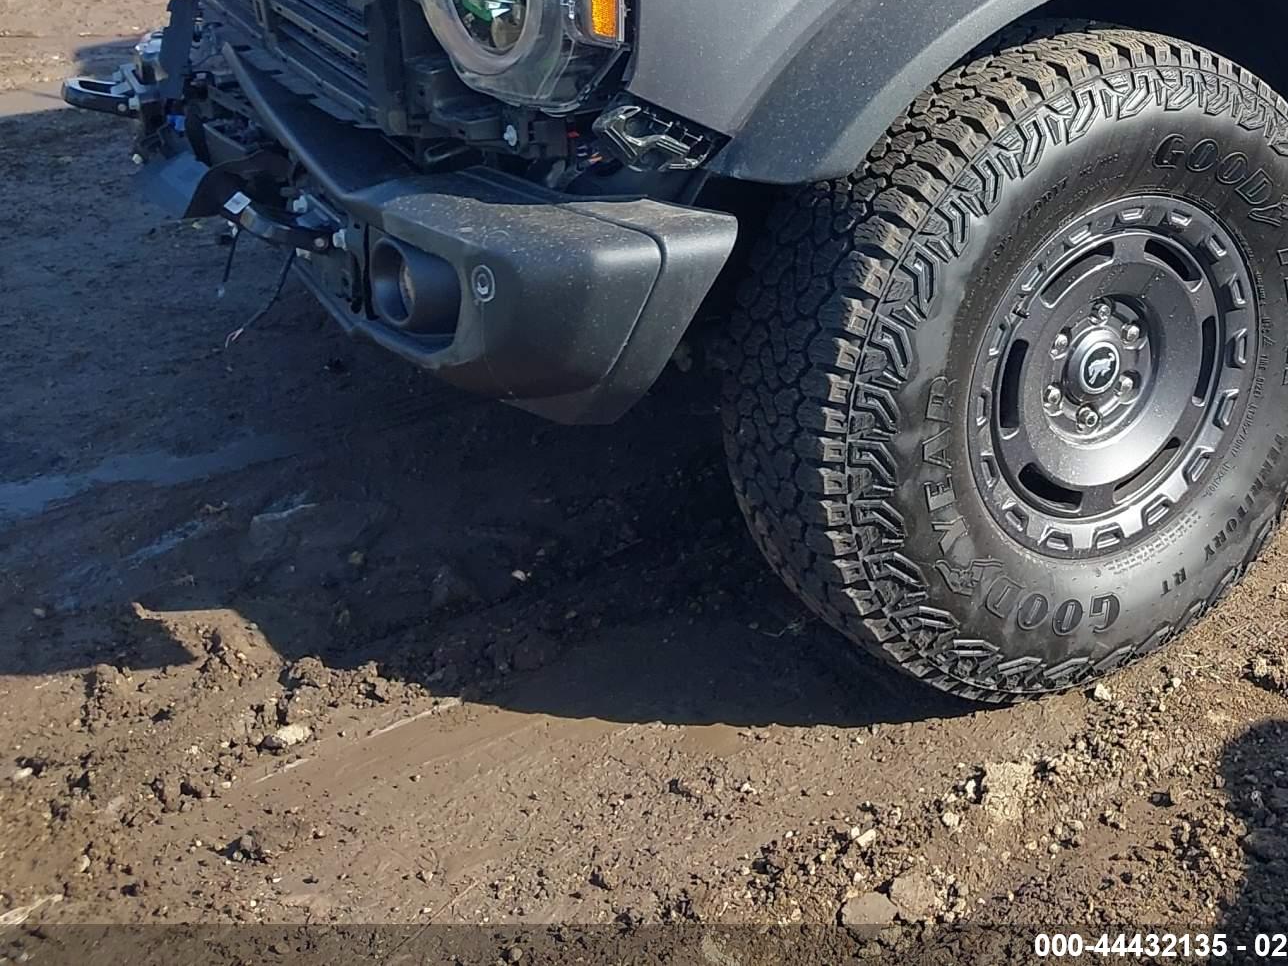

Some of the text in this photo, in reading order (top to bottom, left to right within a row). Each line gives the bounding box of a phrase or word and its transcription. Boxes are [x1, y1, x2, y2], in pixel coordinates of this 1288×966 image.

[922, 376, 1121, 637] GOODYEAR
[1204, 433, 1288, 561] TERRITORY
[1160, 567, 1187, 596] RT
